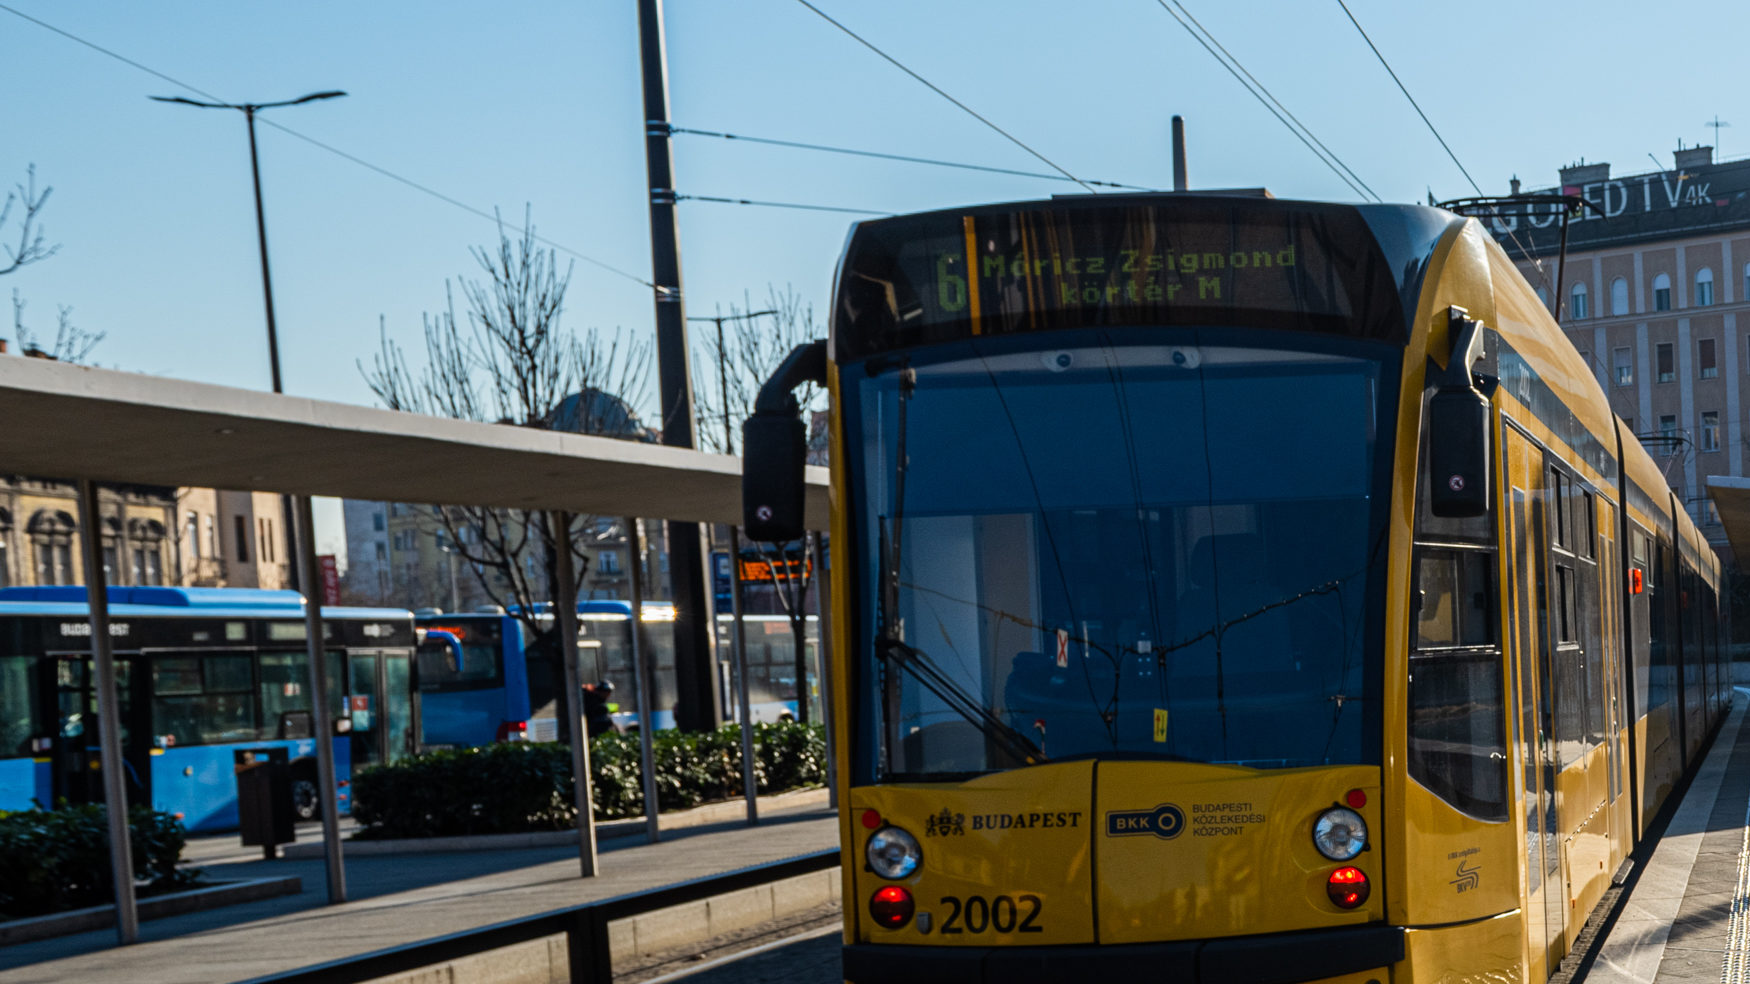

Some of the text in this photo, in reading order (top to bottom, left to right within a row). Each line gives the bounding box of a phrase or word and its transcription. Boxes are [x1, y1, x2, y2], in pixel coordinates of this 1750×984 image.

[1526, 180, 1628, 230] OLED
[982, 245, 1296, 279] Móricz Zsigmond
[936, 251, 967, 312] 6
[1061, 276, 1223, 305] körtér M
[1192, 802, 1253, 813] BUDAPESTI
[1192, 813, 1266, 825] KÖZLEKEDÉSI
[971, 812, 1082, 830] BUDAPEST
[1115, 817, 1150, 830] BKK
[1192, 825, 1245, 837] KÖZPONT
[939, 893, 1044, 935] 2002
